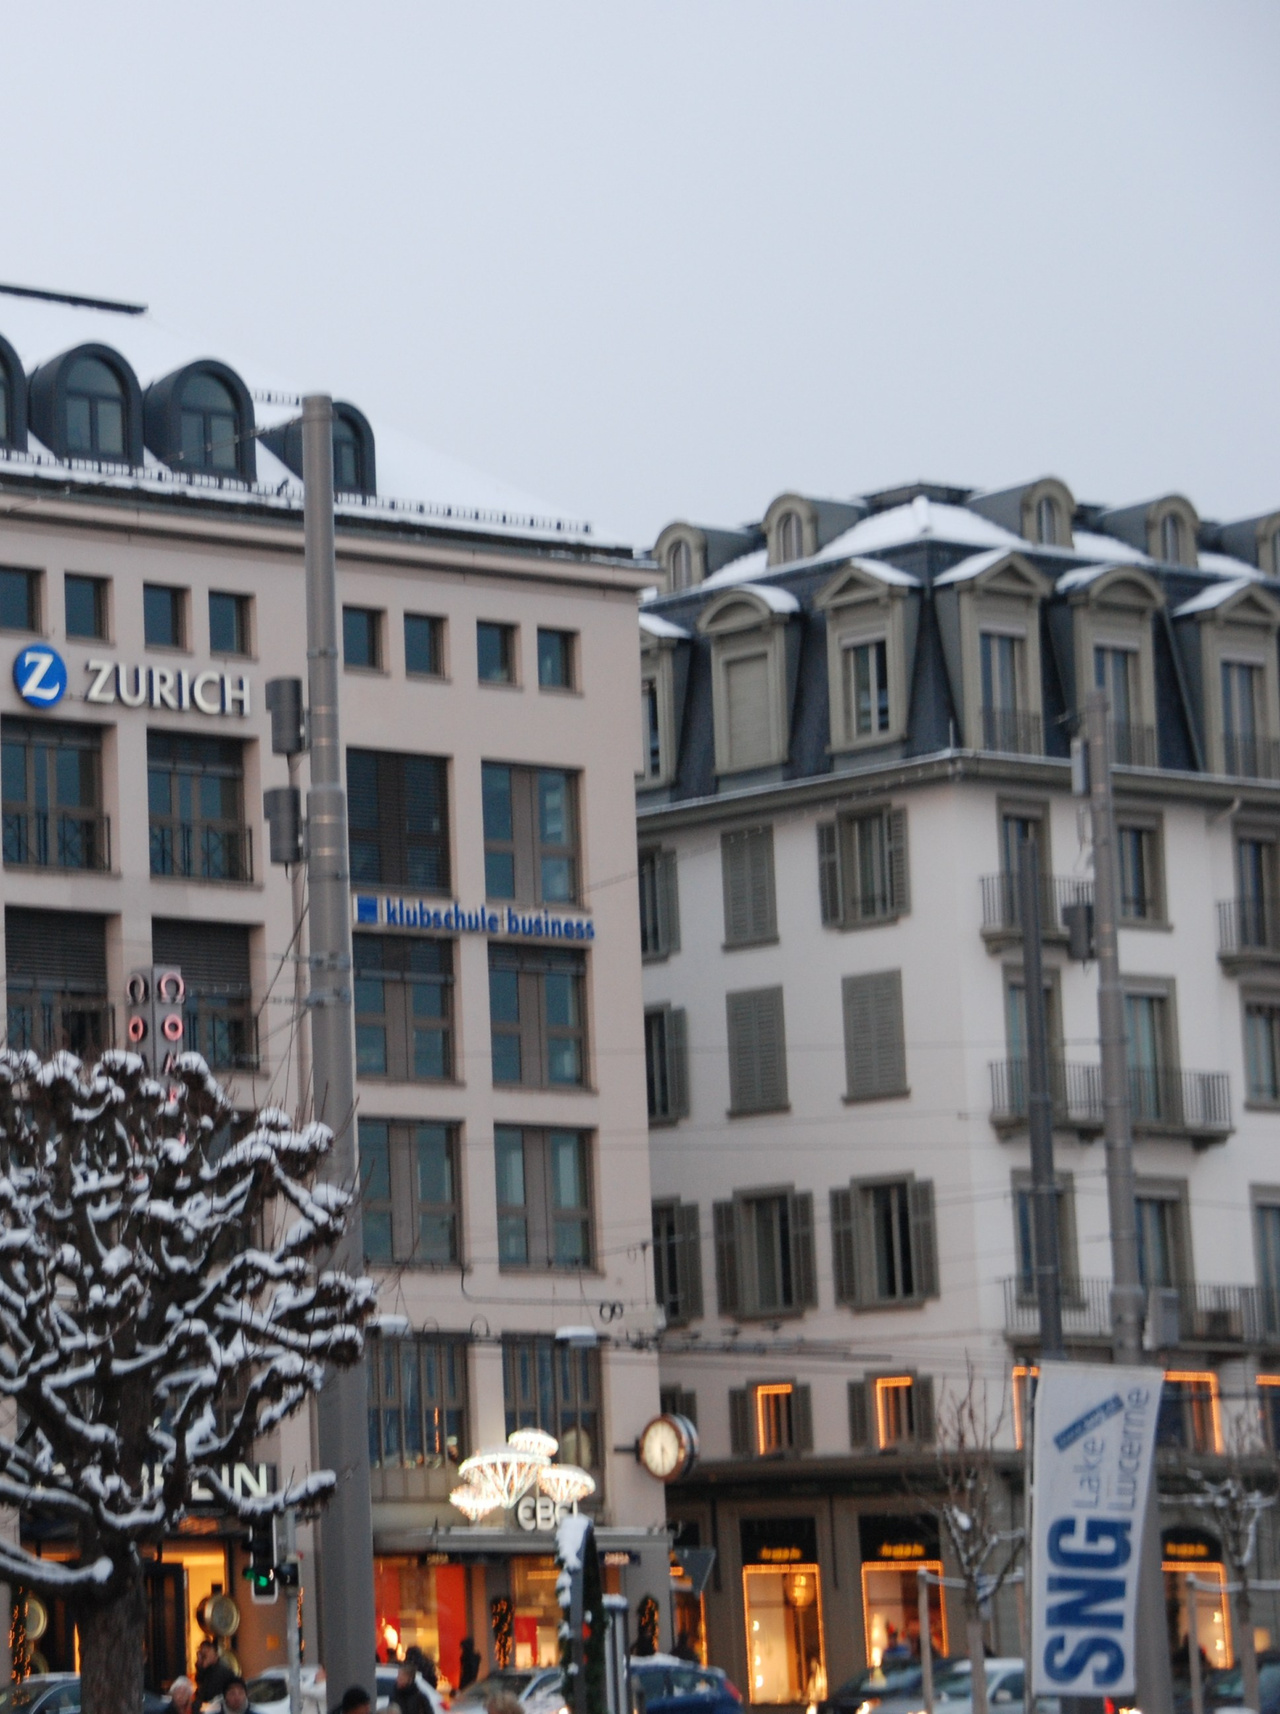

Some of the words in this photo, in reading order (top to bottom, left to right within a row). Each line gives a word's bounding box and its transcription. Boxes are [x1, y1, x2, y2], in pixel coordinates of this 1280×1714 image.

[86, 658, 251, 718] ZURICH
[385, 895, 499, 933] klubschule
[506, 905, 596, 940] business
[1072, 1437, 1105, 1509] Lake
[1105, 1386, 1150, 1512] Lucerne
[1043, 1517, 1133, 1688] SNG
